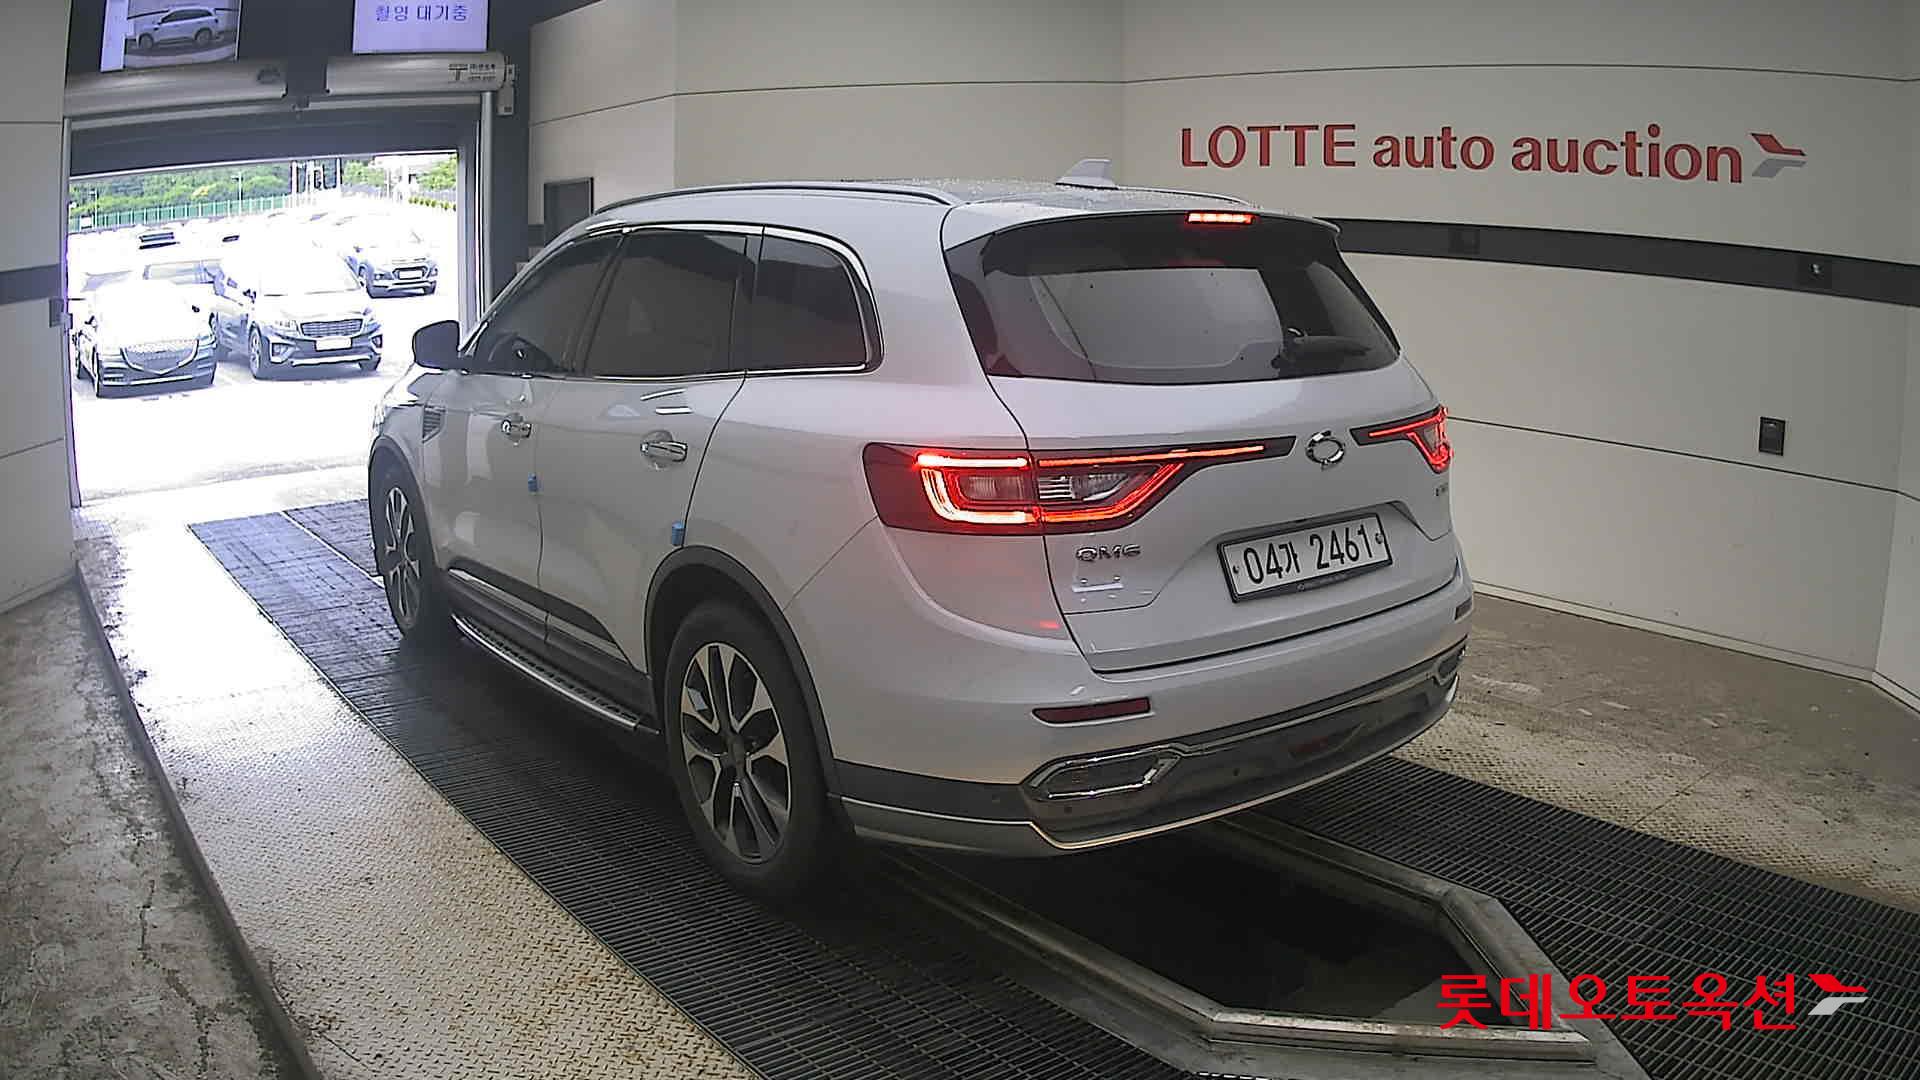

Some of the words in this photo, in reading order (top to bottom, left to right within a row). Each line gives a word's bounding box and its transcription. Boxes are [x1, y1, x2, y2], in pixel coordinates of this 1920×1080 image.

[417, 5, 468, 21] 대기중
[1181, 124, 1356, 168] LOTTE
[1372, 125, 1495, 170] auto
[1511, 123, 1743, 184] auction
[1243, 541, 1300, 584] 04가
[1309, 524, 1373, 570] 2461
